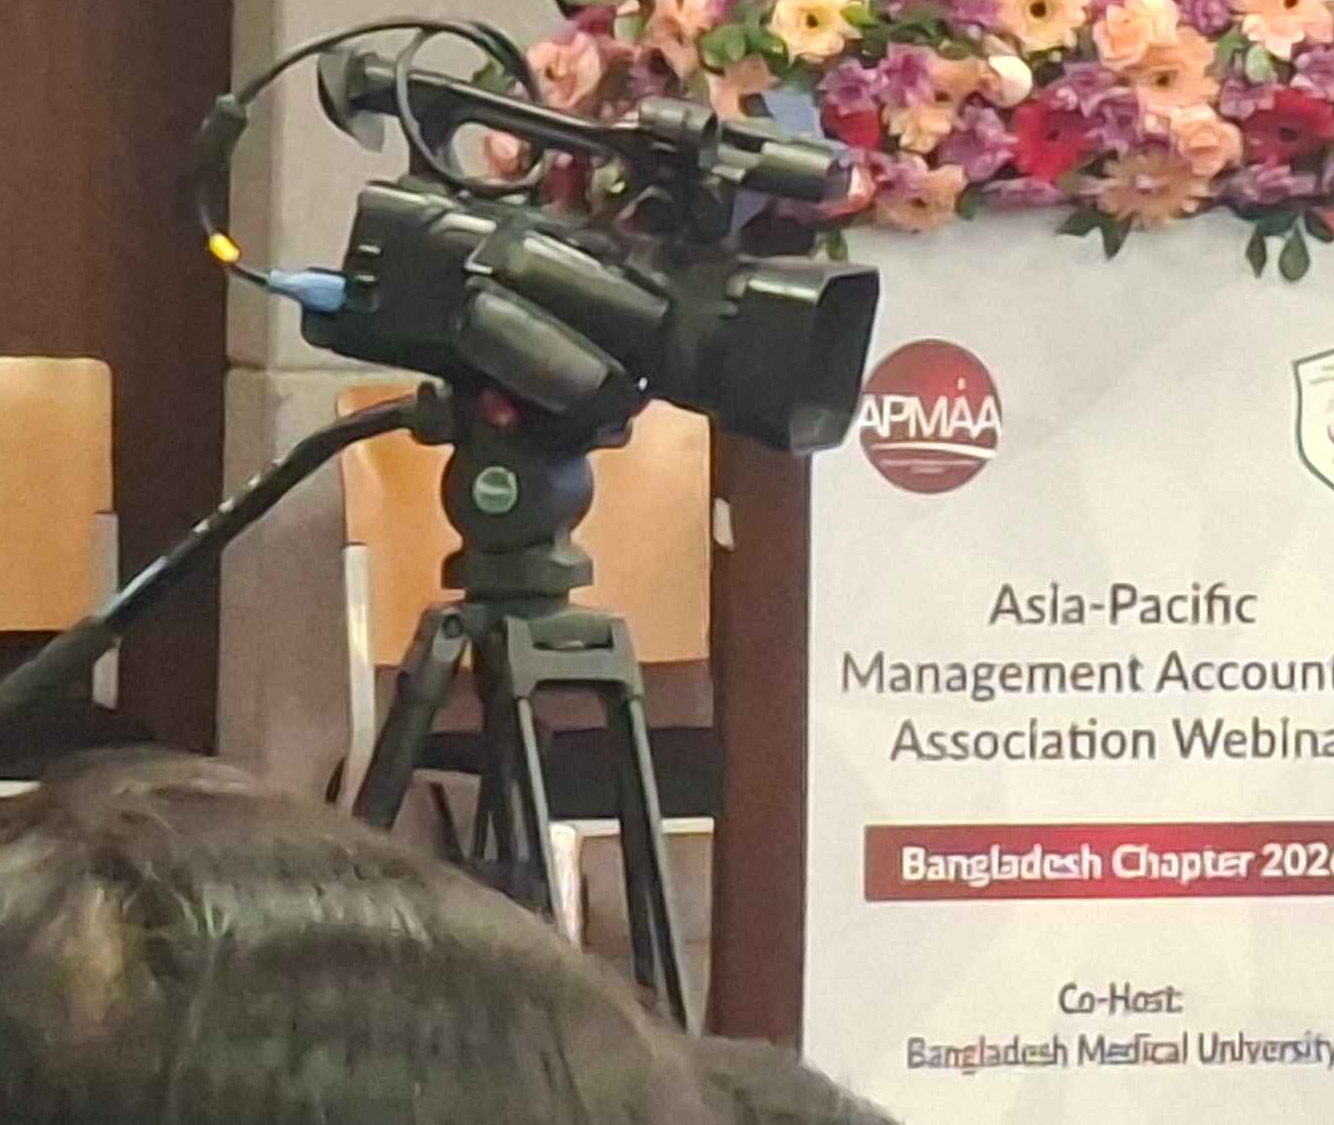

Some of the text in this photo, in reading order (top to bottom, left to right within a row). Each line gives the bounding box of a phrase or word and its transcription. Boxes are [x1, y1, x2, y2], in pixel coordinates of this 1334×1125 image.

[988, 581, 1258, 626] Asia-Pacific
[841, 648, 1145, 702] Management
[888, 716, 1157, 761] Association
[901, 844, 1103, 887] Bangladesh
[1112, 843, 1254, 884] Chapter
[907, 1033, 1068, 1075] Bangladesh
[1076, 1030, 1188, 1067] Medical
